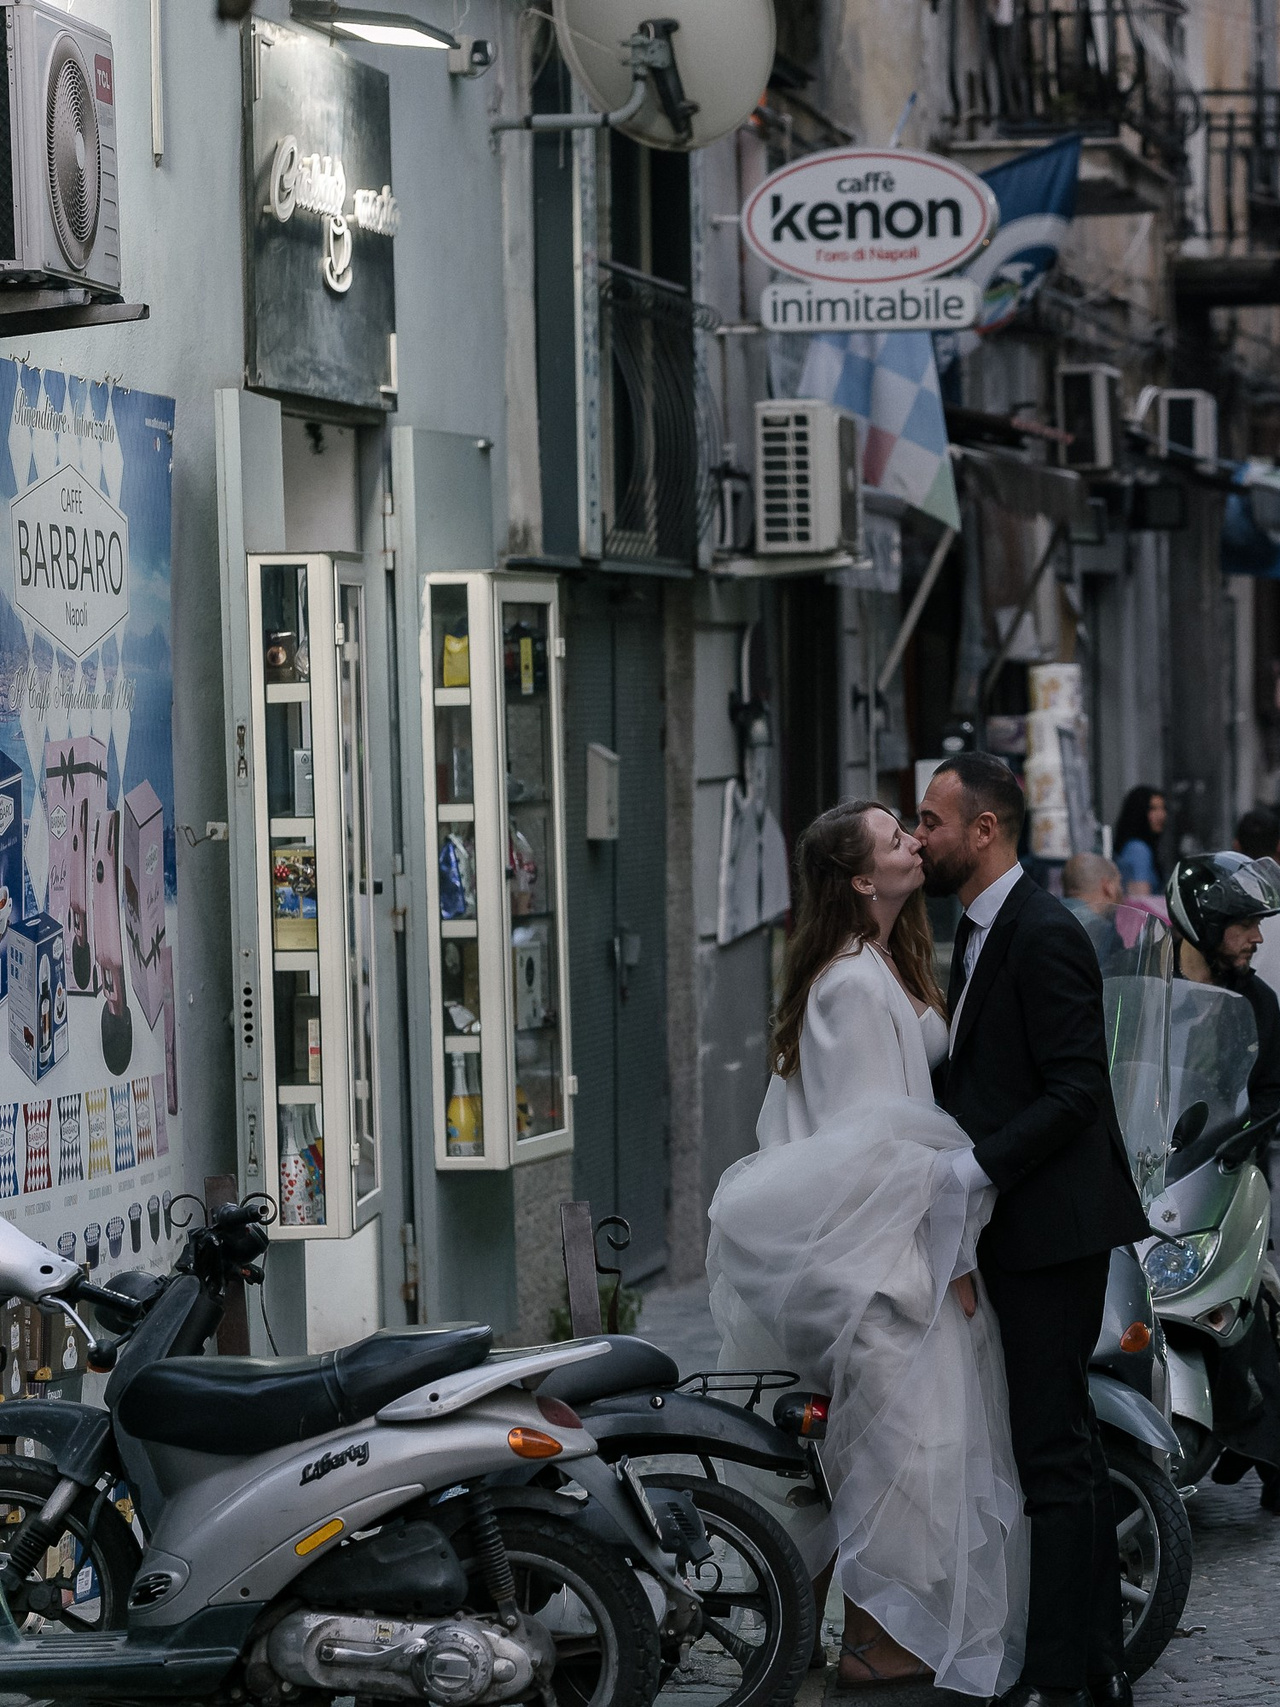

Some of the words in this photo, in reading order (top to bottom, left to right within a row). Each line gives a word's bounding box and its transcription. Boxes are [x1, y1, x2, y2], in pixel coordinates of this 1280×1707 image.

[97, 68, 110, 91] TCL
[837, 171, 895, 193] caffè
[771, 194, 962, 242] kenon
[852, 247, 865, 261] di
[869, 246, 919, 263] Napoli
[771, 288, 964, 323] inimitabile
[15, 388, 67, 434] Rivenditore
[68, 400, 115, 444] Autorizzato
[61, 483, 84, 515] CAFFÈ
[18, 520, 124, 596] BARBARO
[65, 602, 88, 633] Napoli
[300, 1441, 370, 1486] Liberty
